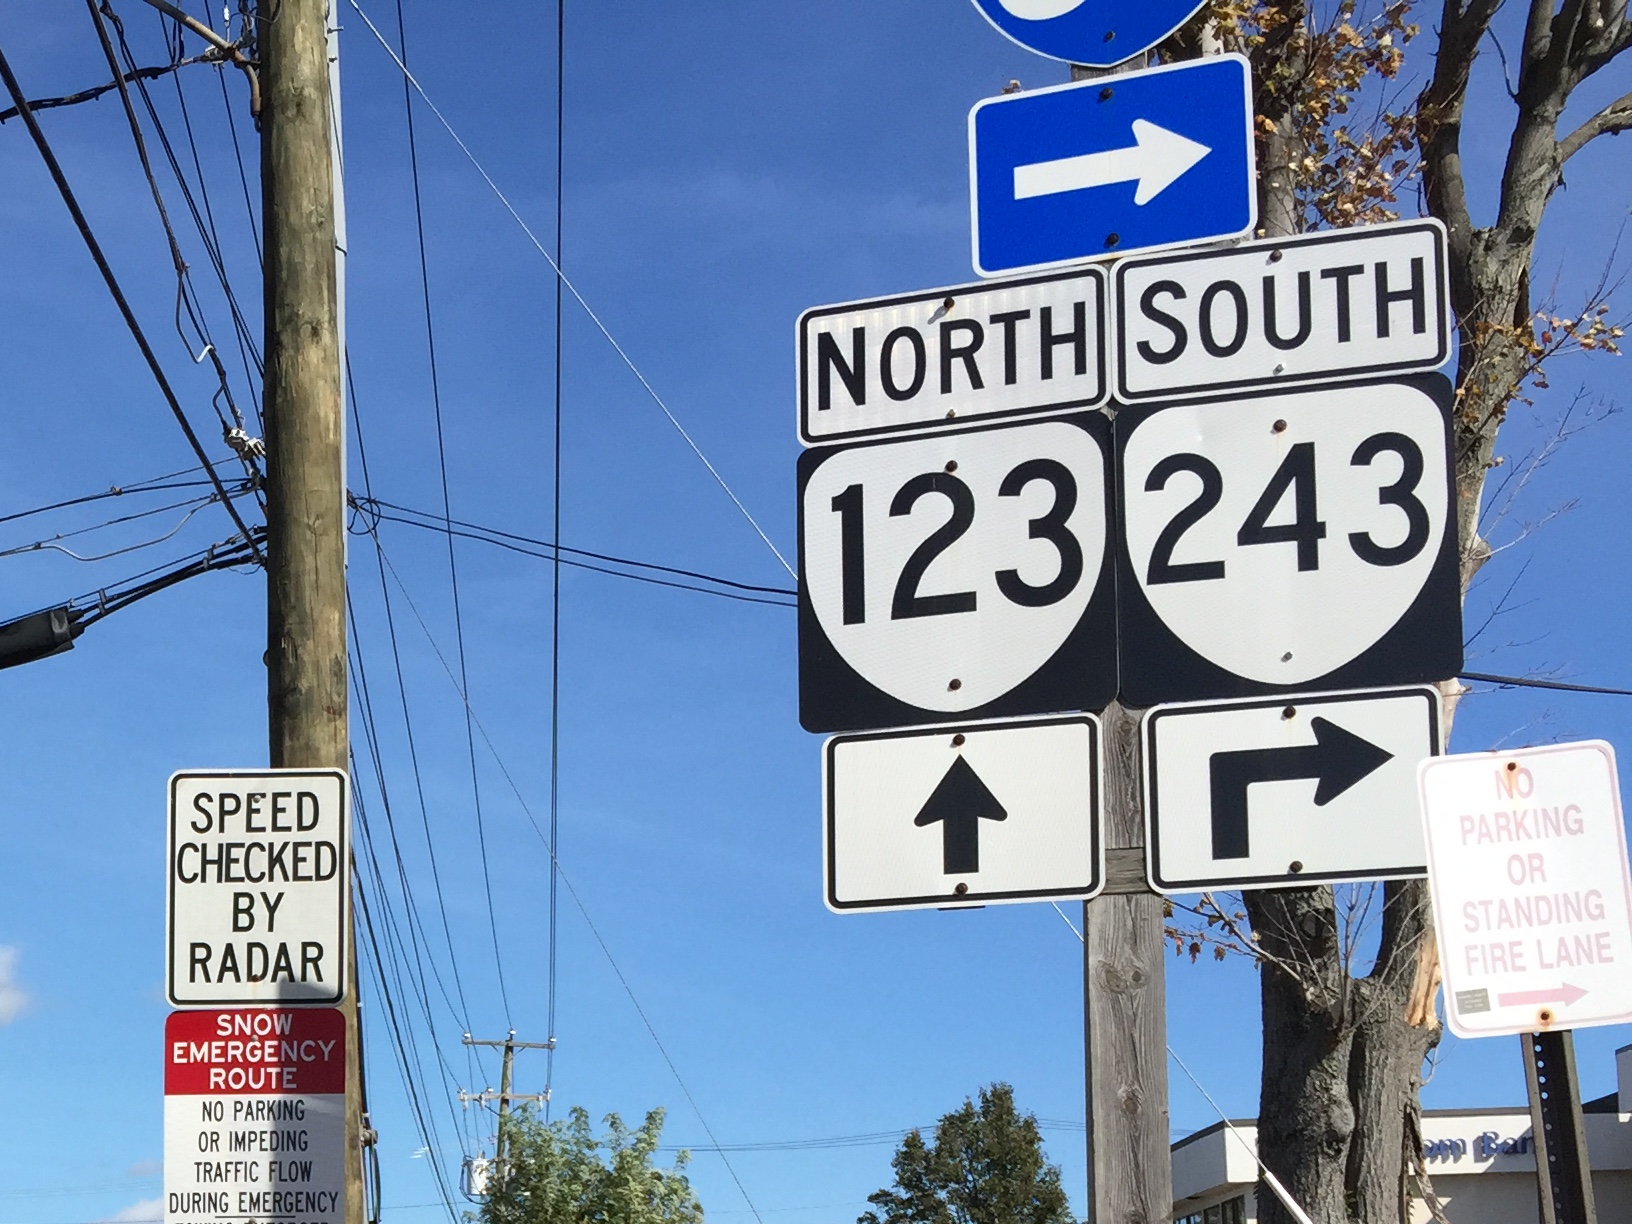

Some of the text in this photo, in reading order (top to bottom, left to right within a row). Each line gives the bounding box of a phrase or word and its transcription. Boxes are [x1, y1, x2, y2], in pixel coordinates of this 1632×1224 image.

[1136, 256, 1425, 366] SOUTH
[818, 302, 1087, 411] NORTH
[1144, 431, 1431, 587] 243
[831, 457, 1085, 627] 123
[1495, 767, 1535, 801] NO
[190, 791, 320, 834] SPEED
[1459, 804, 1585, 846] PARKING
[176, 840, 338, 885] CHECKED
[1507, 852, 1548, 886] OR
[231, 891, 285, 933] BY
[1462, 888, 1607, 933] STANDING
[189, 941, 324, 984] RADAR
[1464, 931, 1615, 977] FIRE LANE
[216, 1013, 293, 1037] SNOW
[173, 1039, 336, 1064] EMERGENCY
[209, 1066, 298, 1090] ROUTE
[202, 1099, 306, 1122] NO PARKING
[198, 1130, 308, 1153] OR IMPEDING
[194, 1160, 312, 1183] TRAFFIC FLOW
[169, 1191, 339, 1214] DURING EMERGENCY
